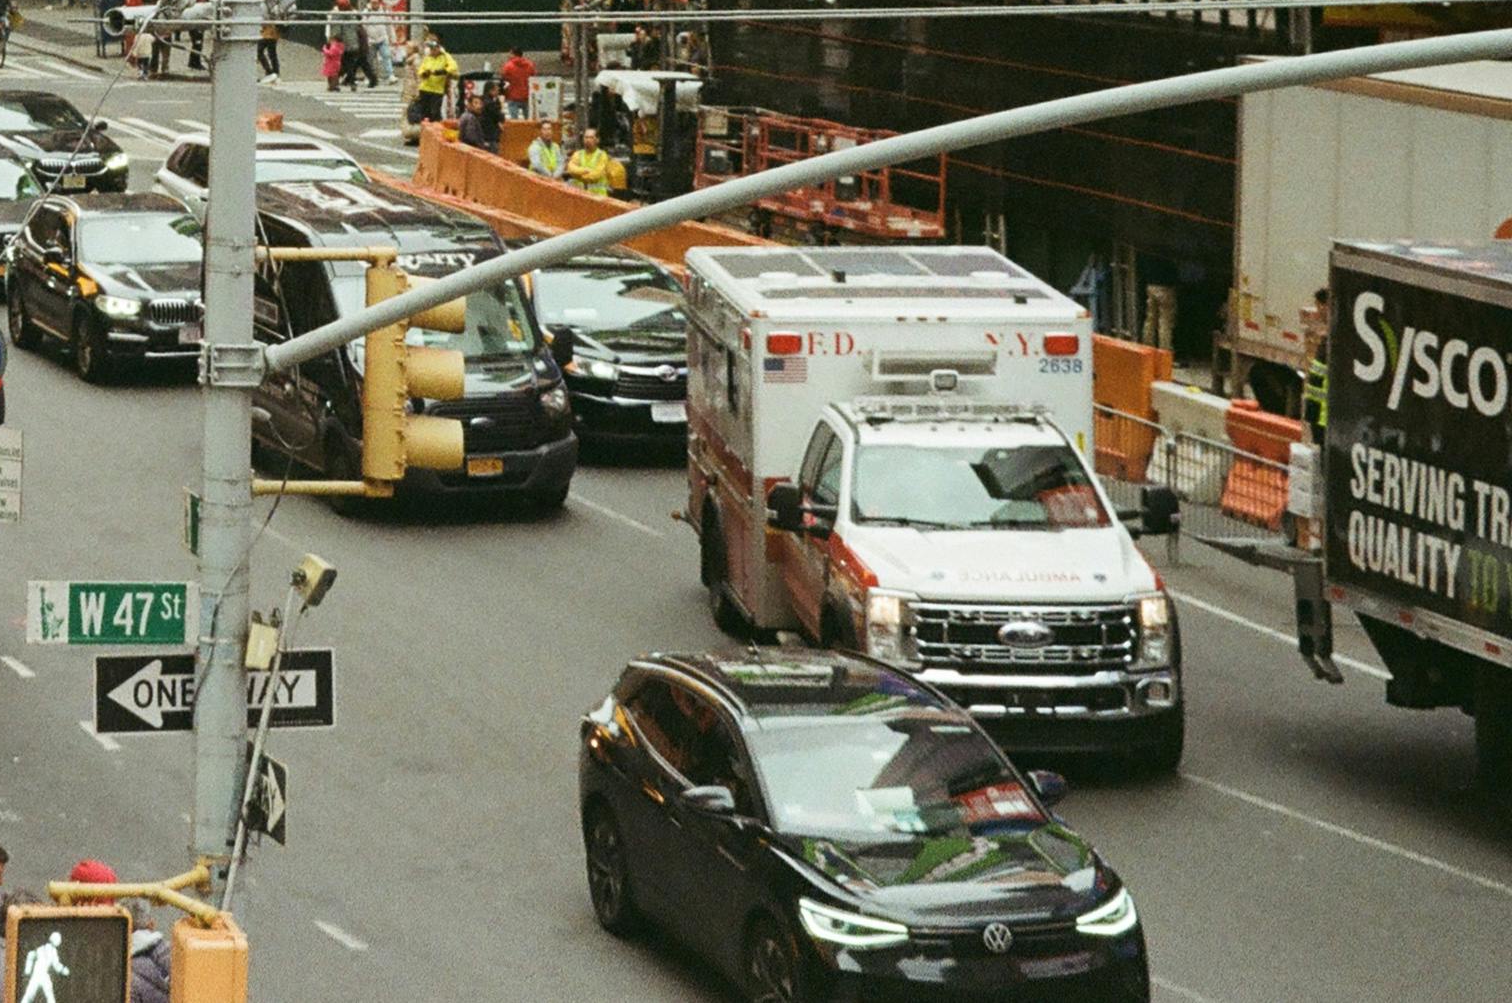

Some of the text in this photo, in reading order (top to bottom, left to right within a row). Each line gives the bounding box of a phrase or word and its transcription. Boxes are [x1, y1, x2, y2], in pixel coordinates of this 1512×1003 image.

[1039, 358, 1083, 374] 2638
[1349, 442, 1512, 549] SERVING TR
[1348, 509, 1462, 599] QUALITY
[78, 591, 181, 637] W 47 St
[132, 677, 195, 710] ONE
